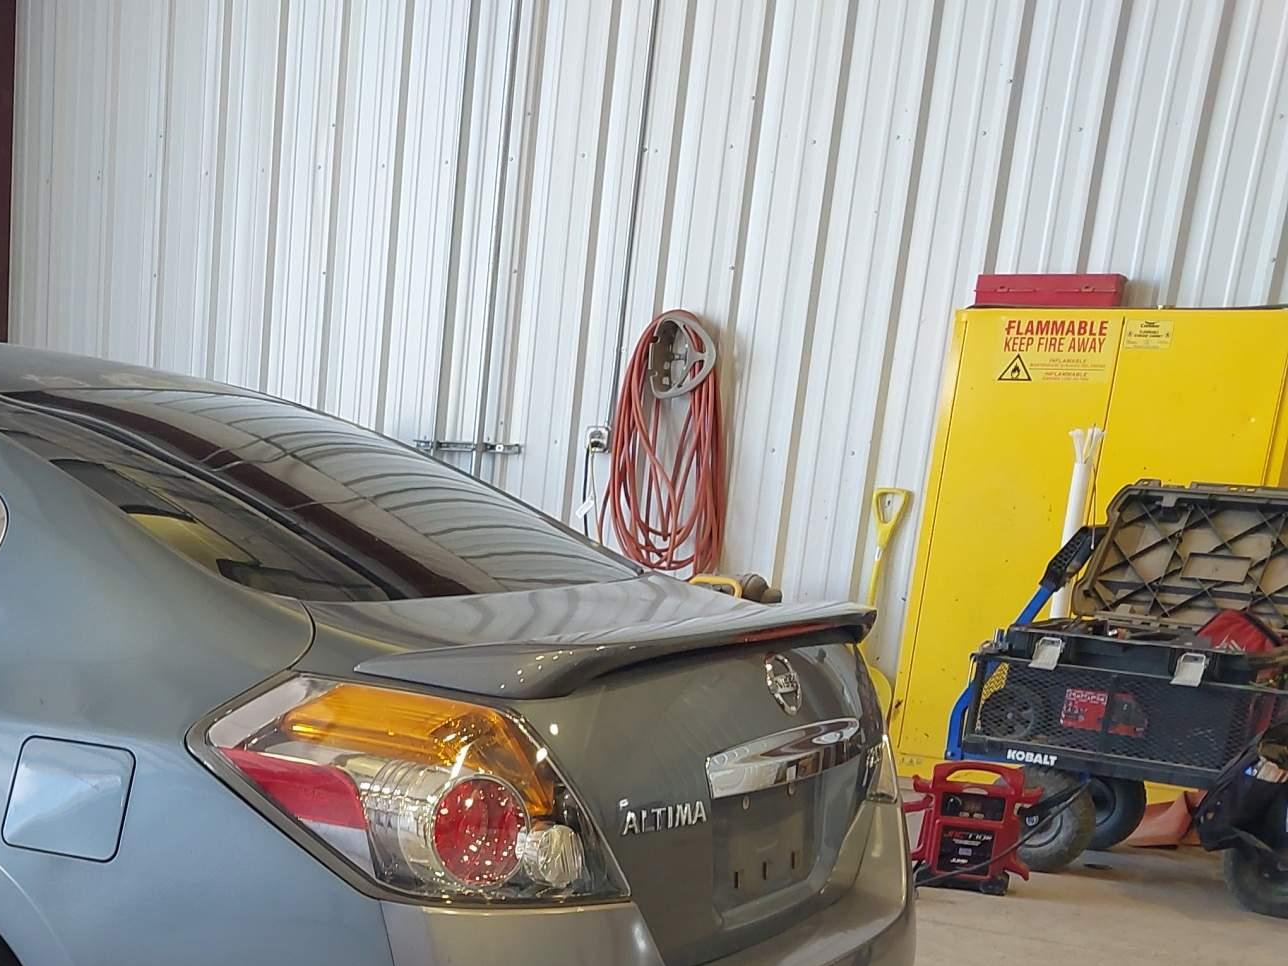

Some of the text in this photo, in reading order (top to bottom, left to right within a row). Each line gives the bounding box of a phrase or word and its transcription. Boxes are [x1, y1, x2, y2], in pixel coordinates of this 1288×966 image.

[1005, 319, 1109, 336] FLAMMABLE
[1003, 337, 1106, 352] KEEP FIRE AWAY
[1007, 749, 1057, 766] KOBALT
[622, 801, 707, 835] ALTIMA
